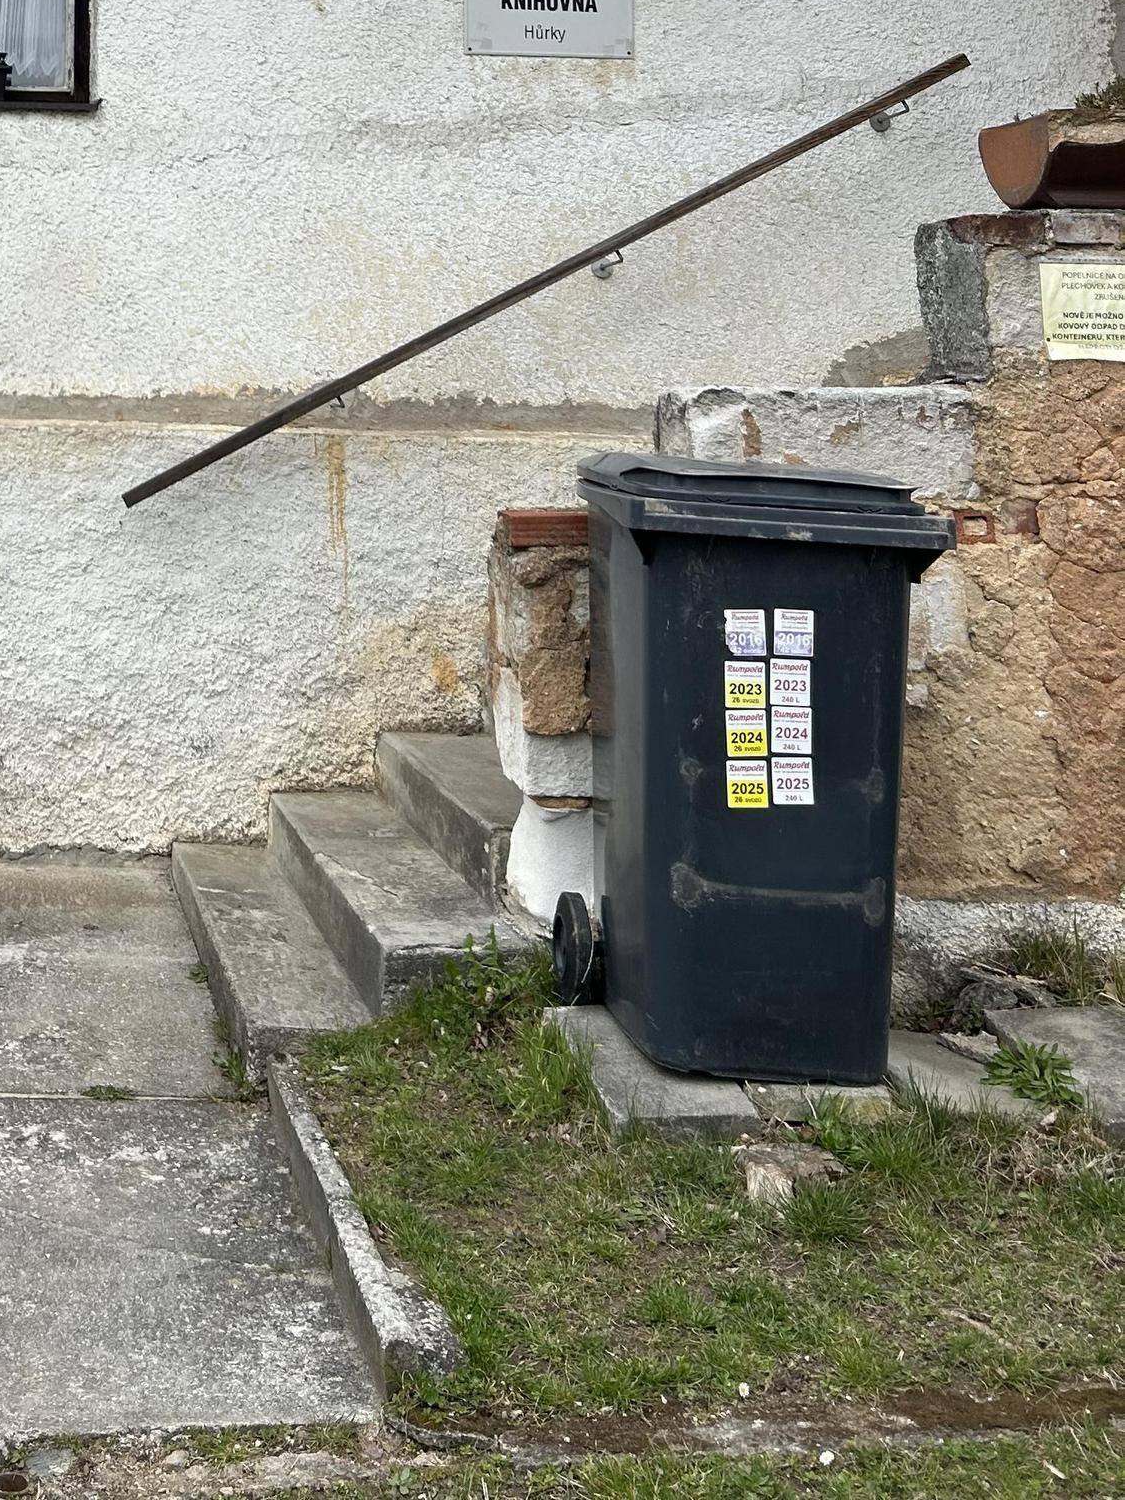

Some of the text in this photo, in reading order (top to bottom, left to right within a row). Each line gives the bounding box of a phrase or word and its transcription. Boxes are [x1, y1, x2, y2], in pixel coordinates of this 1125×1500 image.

[524, 24, 566, 43] Hůrky
[1062, 271, 1104, 279] POPELNICE
[1118, 272, 1125, 280] O
[1094, 292, 1125, 300] ZRUŠEN
[1063, 311, 1084, 319] NOVĚ
[1095, 311, 1124, 320] MOŽNO
[729, 632, 763, 646] 2016
[778, 632, 811, 646] 2016
[727, 665, 763, 674] Rumpold
[772, 662, 808, 671] Rumpold
[729, 683, 762, 695] 2023
[774, 679, 807, 692] 2023
[728, 713, 764, 722] Rumpold
[774, 710, 810, 719] Rumpold
[731, 732, 763, 744] 2024
[775, 727, 808, 739] 2024
[728, 764, 765, 773] Rumpold
[773, 761, 810, 770] Rumpold
[731, 783, 764, 795] 2025
[776, 778, 810, 790] 2025
